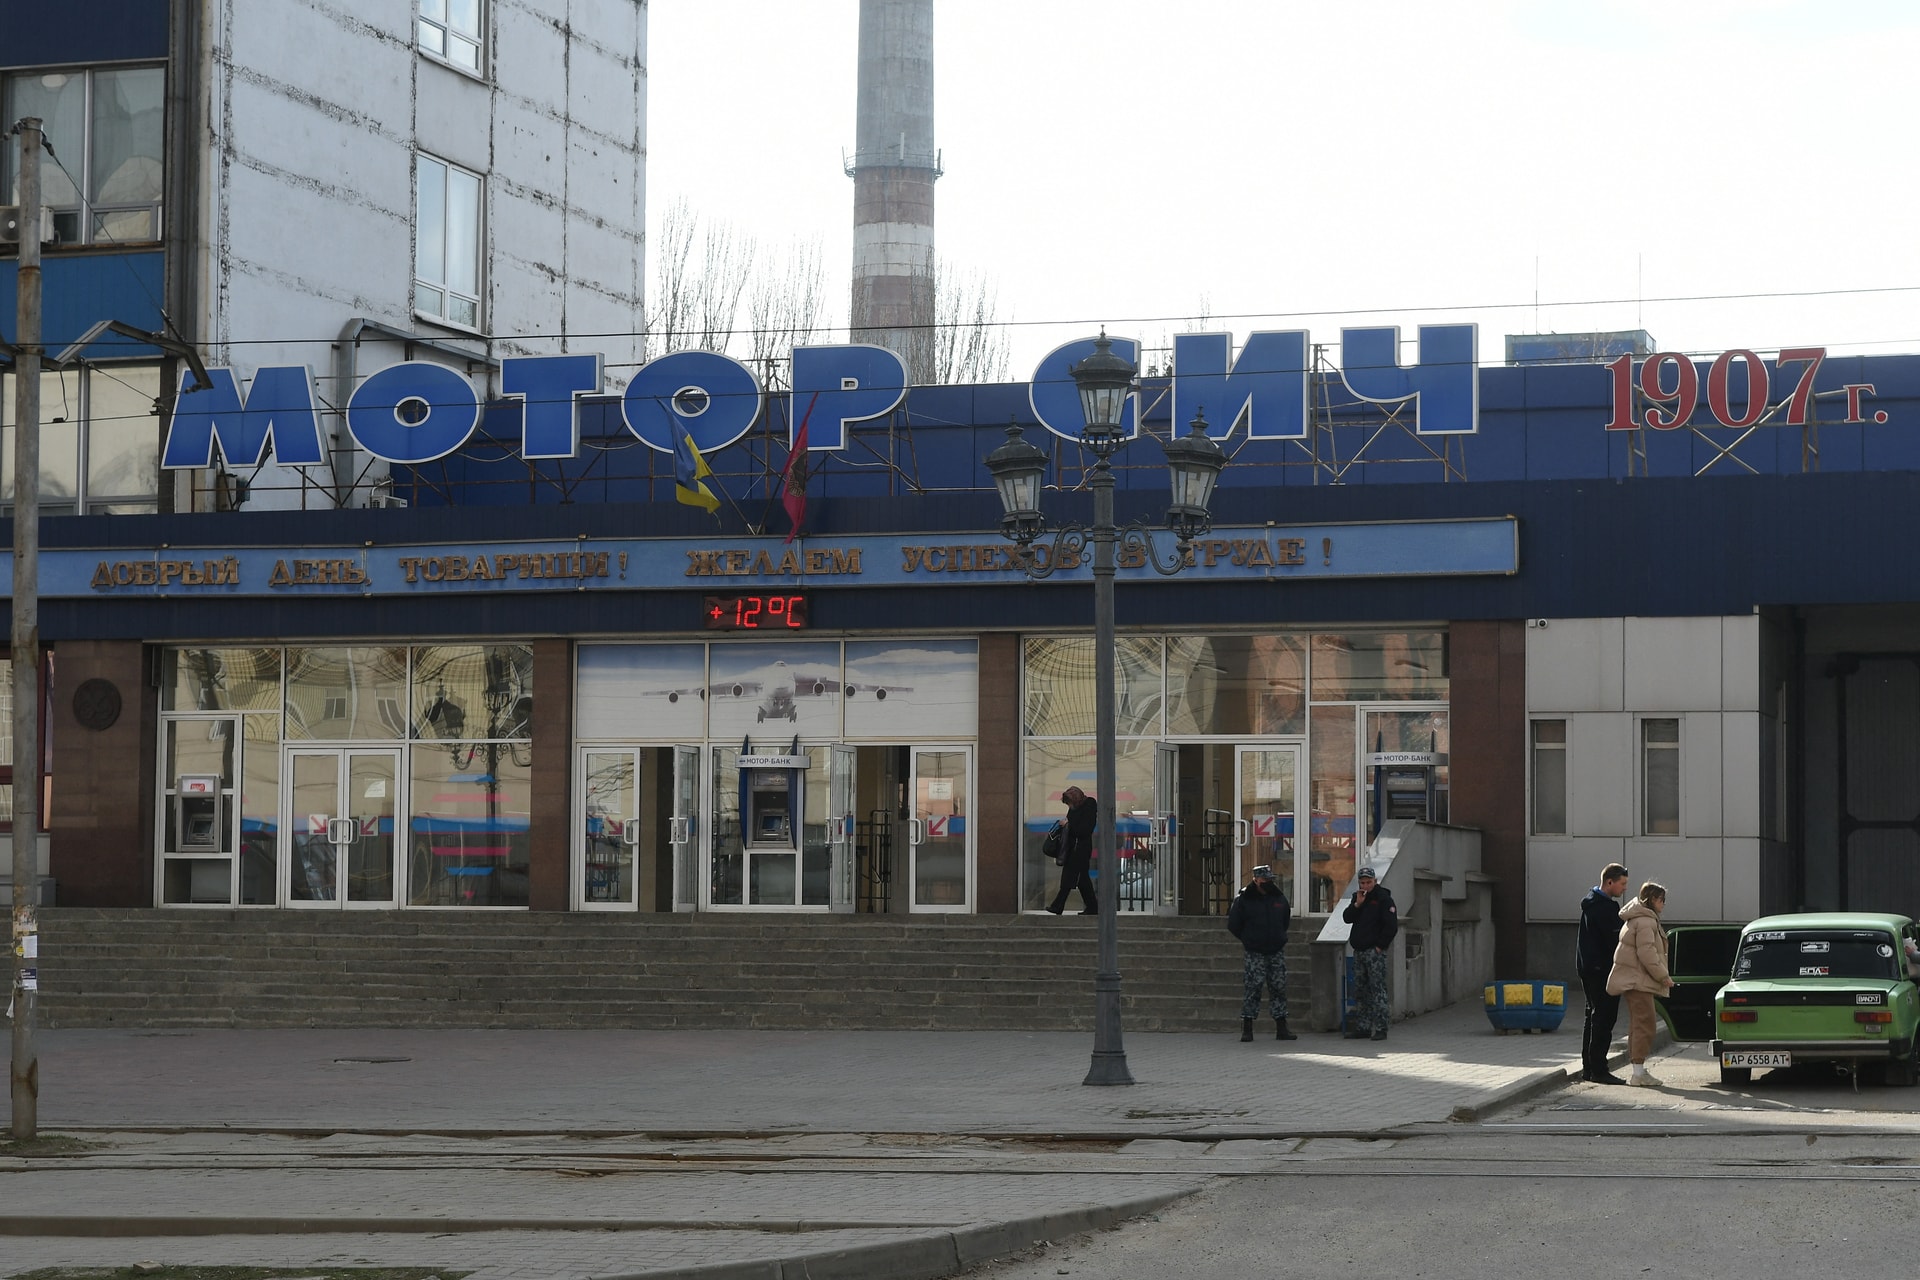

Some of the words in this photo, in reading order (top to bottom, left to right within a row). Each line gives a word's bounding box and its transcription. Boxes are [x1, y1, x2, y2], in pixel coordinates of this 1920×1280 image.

[161, 343, 909, 470] МОТОР
[1028, 322, 1479, 444] СИЧ
[1604, 347, 1828, 432] 1907
[91, 556, 240, 588] ДОБРЫЙ
[268, 559, 372, 587] ДЕНЬ,
[685, 548, 862, 577] ЖЕЛАЕМ
[902, 543, 1082, 573] УСПЕХОВ
[1119, 542, 1147, 569] В
[746, 757, 791, 765] МОТОР-БАНК
[1730, 1055, 1745, 1065] AP
[1747, 1055, 1770, 1065] 6558
[1772, 1055, 1787, 1065] AT
